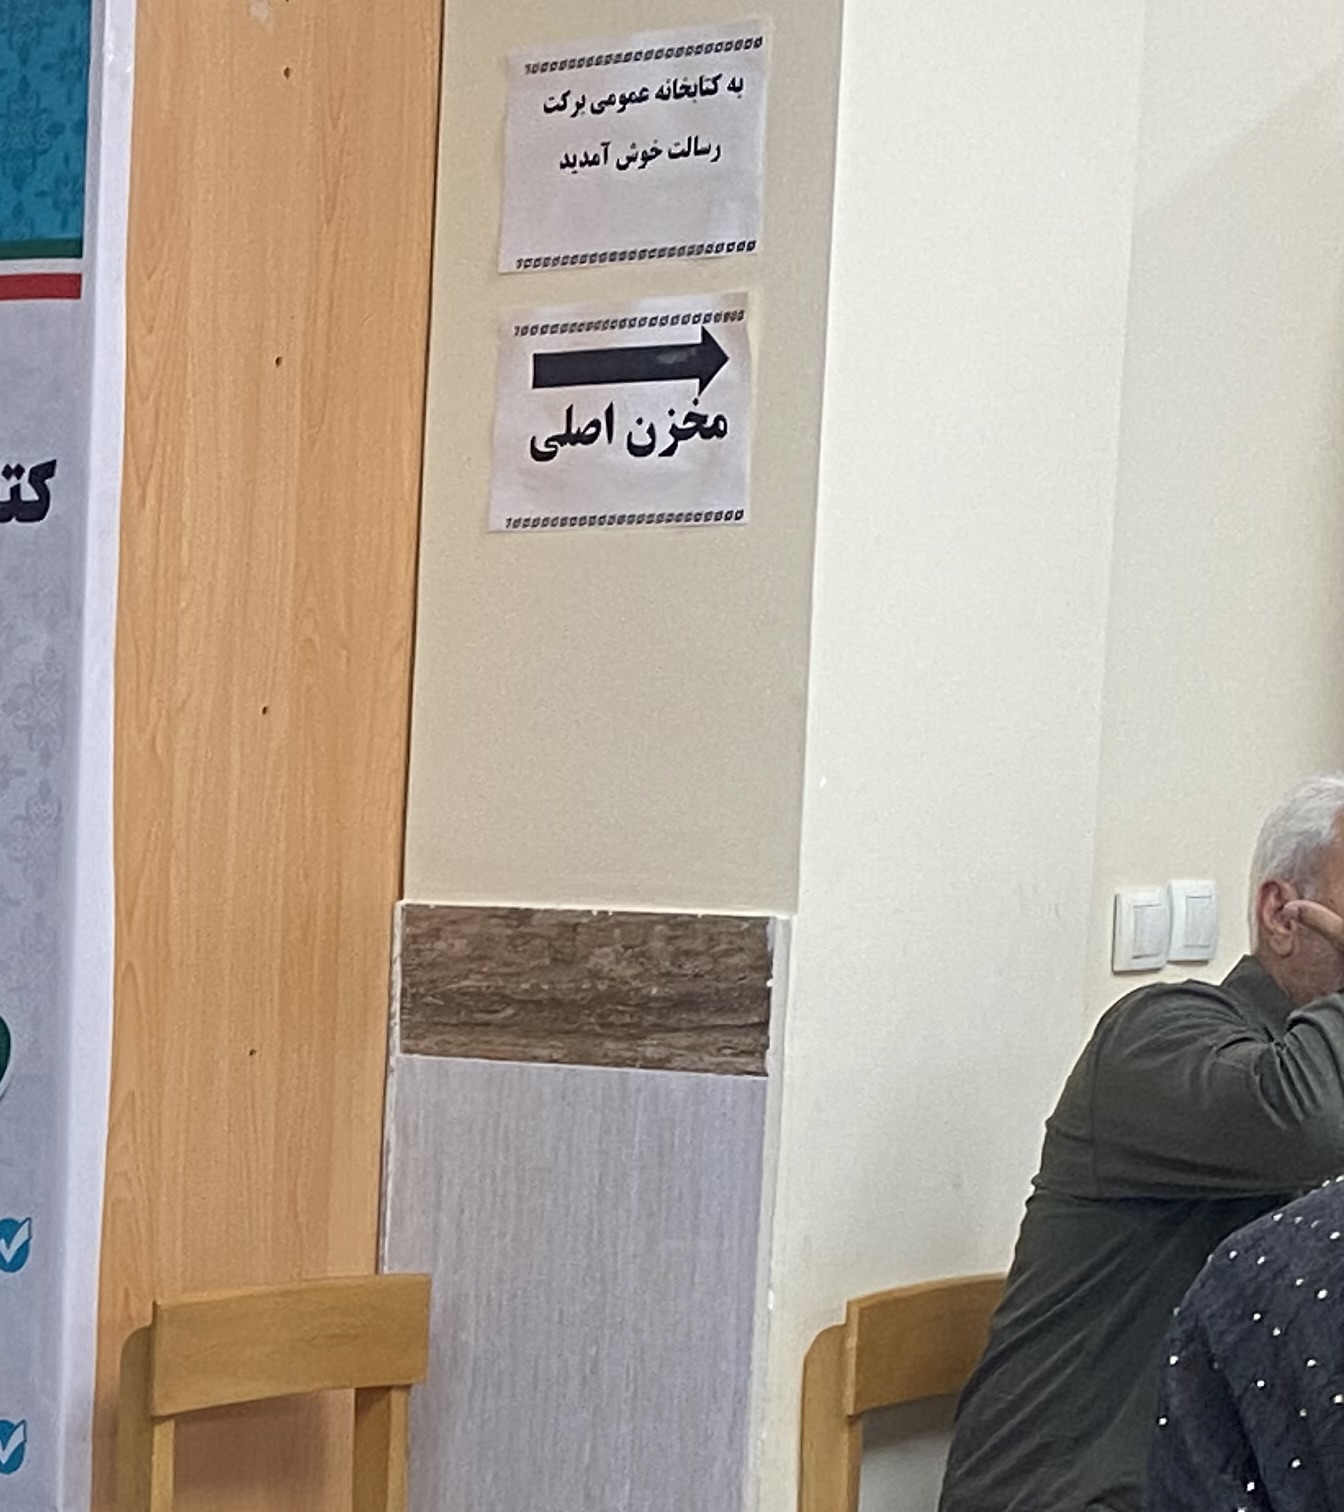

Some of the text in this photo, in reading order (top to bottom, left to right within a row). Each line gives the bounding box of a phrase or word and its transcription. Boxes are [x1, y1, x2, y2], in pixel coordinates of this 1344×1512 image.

[543, 73, 744, 118] به کتابخانه عمومی برکت
[559, 135, 722, 175] رسالت خوش آمدید
[529, 397, 729, 463] مخزن اصلی
